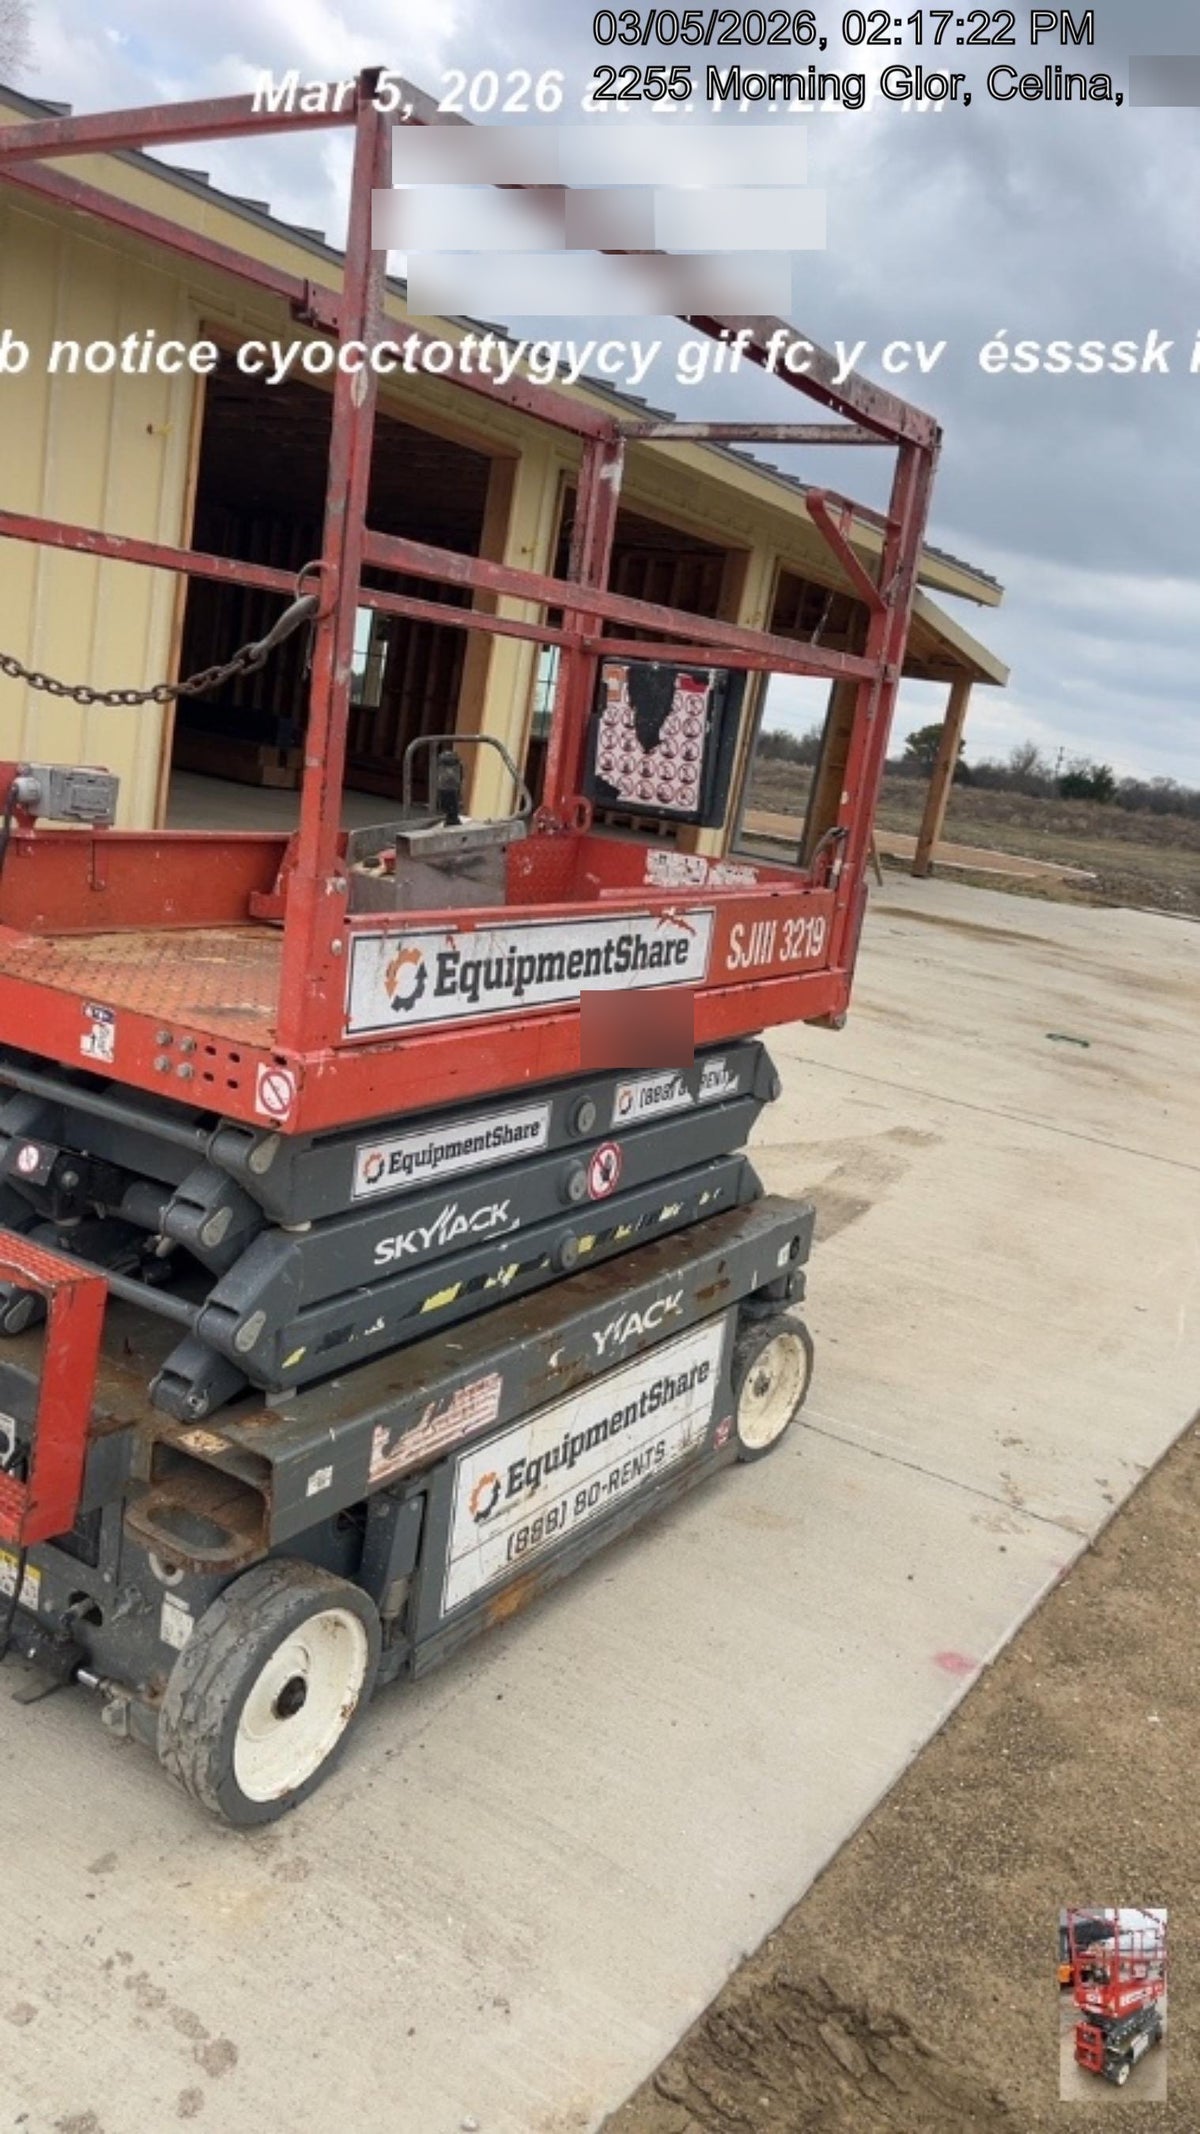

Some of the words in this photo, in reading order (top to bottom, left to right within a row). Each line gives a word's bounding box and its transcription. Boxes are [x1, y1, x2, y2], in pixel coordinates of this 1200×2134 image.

[434, 933, 690, 1002] EquipmentShare
[779, 915, 827, 962] 3219
[388, 1120, 541, 1175] EquipmentShare
[373, 1199, 511, 1266] SKYJACK
[504, 1358, 711, 1499] EquipmentShare
